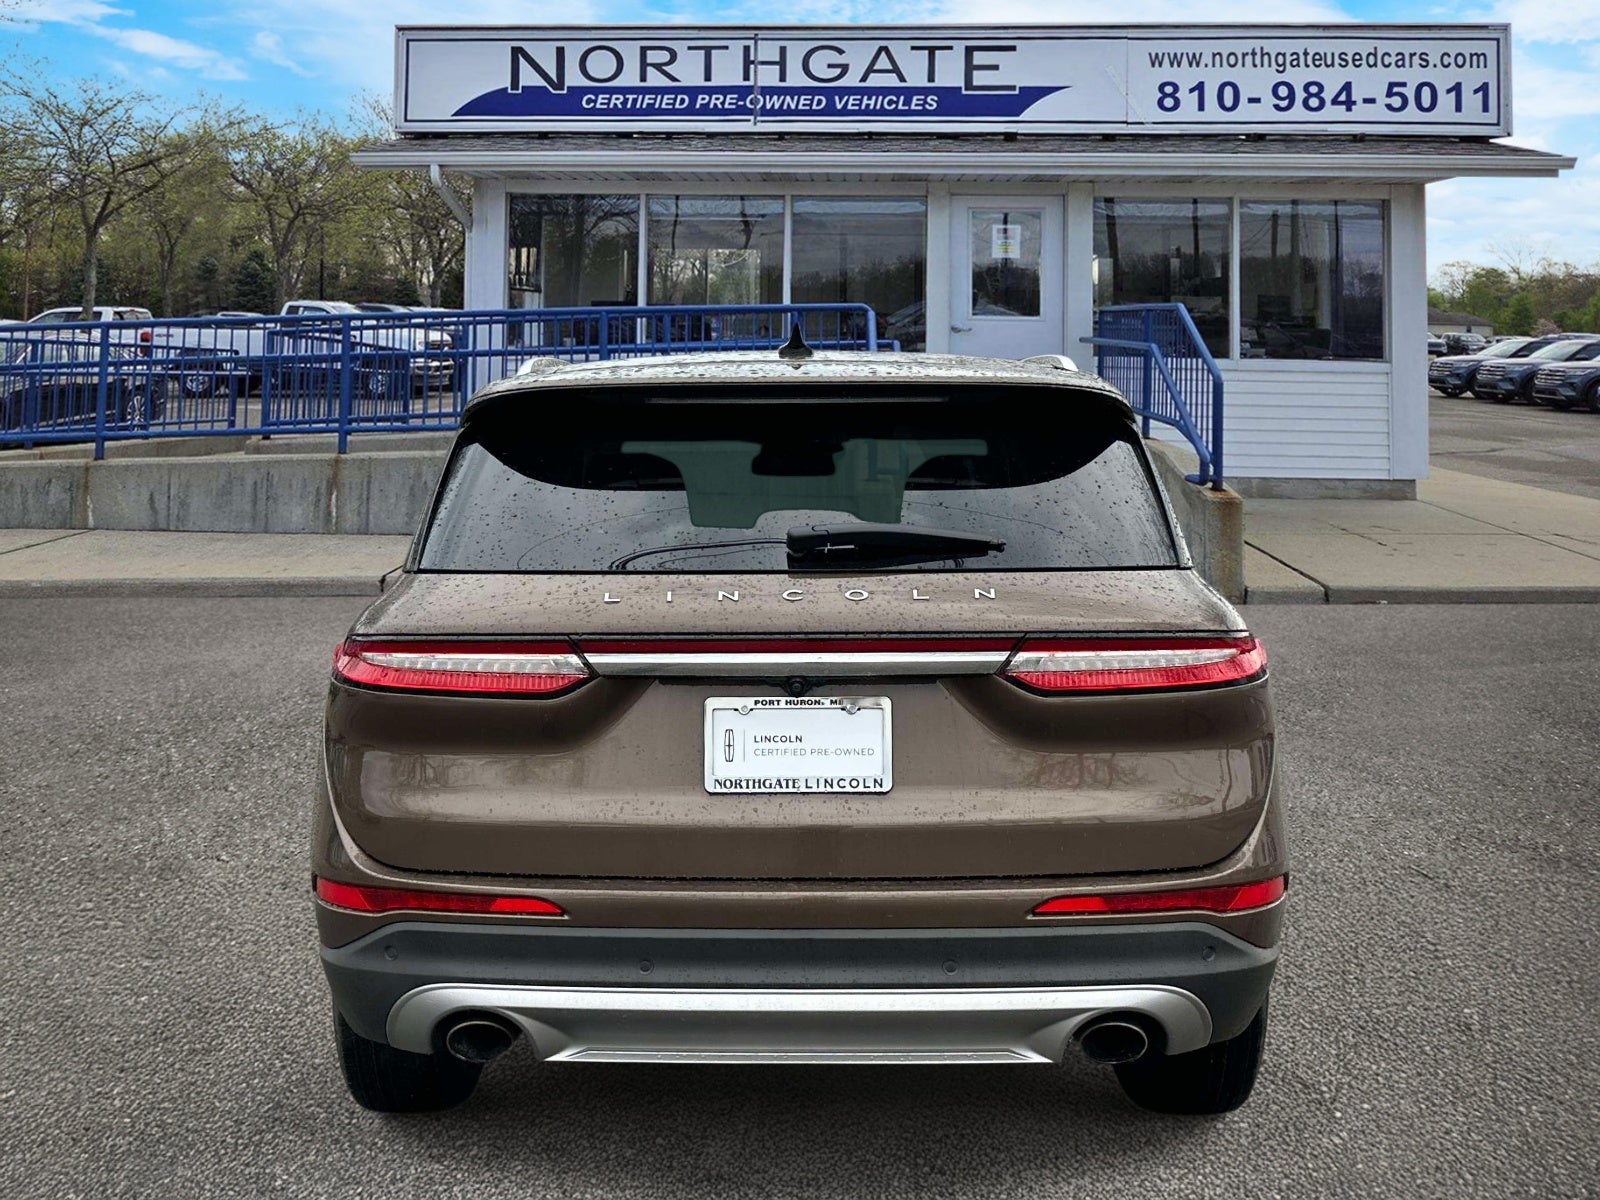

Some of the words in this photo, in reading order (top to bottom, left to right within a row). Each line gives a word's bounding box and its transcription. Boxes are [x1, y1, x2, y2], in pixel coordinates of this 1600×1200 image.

[1148, 46, 1488, 74] www.northgateusedcars.com
[510, 45, 1018, 93] NORTHGATE
[581, 93, 690, 110] CERTIFIED
[695, 93, 827, 111] PRE-OWNED
[834, 95, 939, 111] VEHICLES
[1156, 79, 1491, 114] 810-984-5011
[603, 587, 996, 603] LINCOLN
[753, 735, 803, 743] LINCOLN
[753, 748, 807, 756] CERTIFIED
[810, 748, 875, 756] PRE-OWNED
[713, 778, 800, 790] NORTHGATE
[805, 778, 883, 789] LINCOLN
